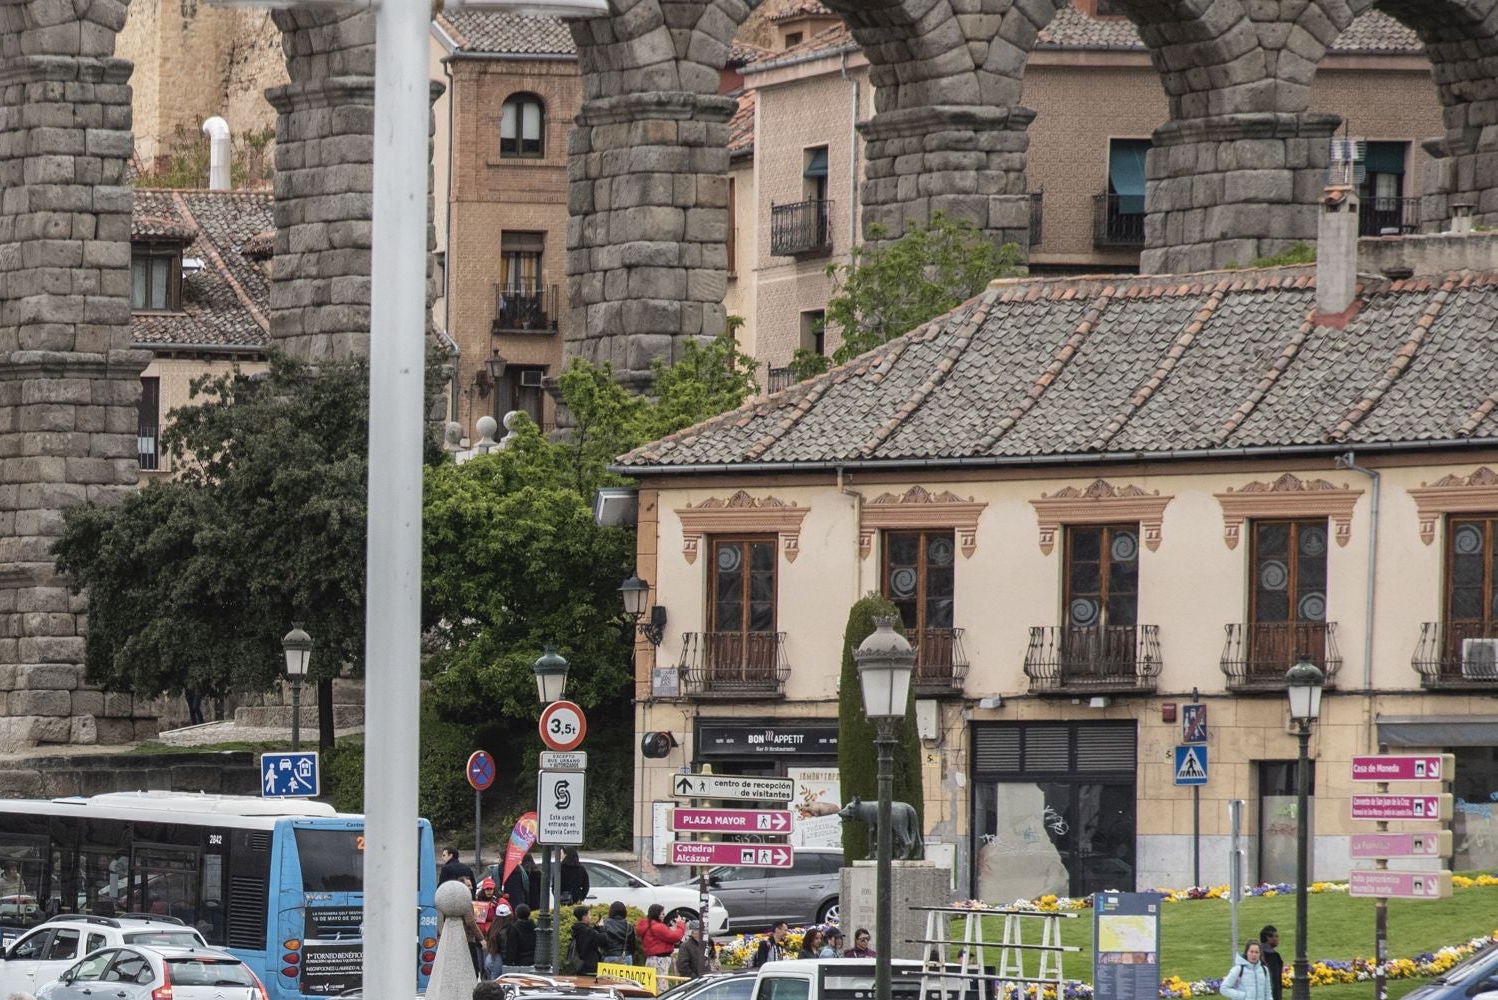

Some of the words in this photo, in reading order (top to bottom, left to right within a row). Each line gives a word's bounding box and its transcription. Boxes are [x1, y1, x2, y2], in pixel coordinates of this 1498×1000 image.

[748, 735, 764, 744] BON
[774, 735, 804, 744] APPETIT
[1353, 764, 1367, 773] Casa
[1377, 764, 1399, 773] Moneda
[714, 780, 740, 788] centro
[741, 780, 751, 788] de
[753, 781, 791, 791] recepción
[752, 789, 791, 798] visitantes
[683, 815, 711, 825] PLAZA
[714, 816, 746, 825] MAYOR
[545, 828, 562, 836] Segovia
[564, 828, 579, 836] Centro
[209, 834, 222, 845] 2842
[676, 844, 715, 854] Catedral
[676, 854, 710, 863] Alcázar
